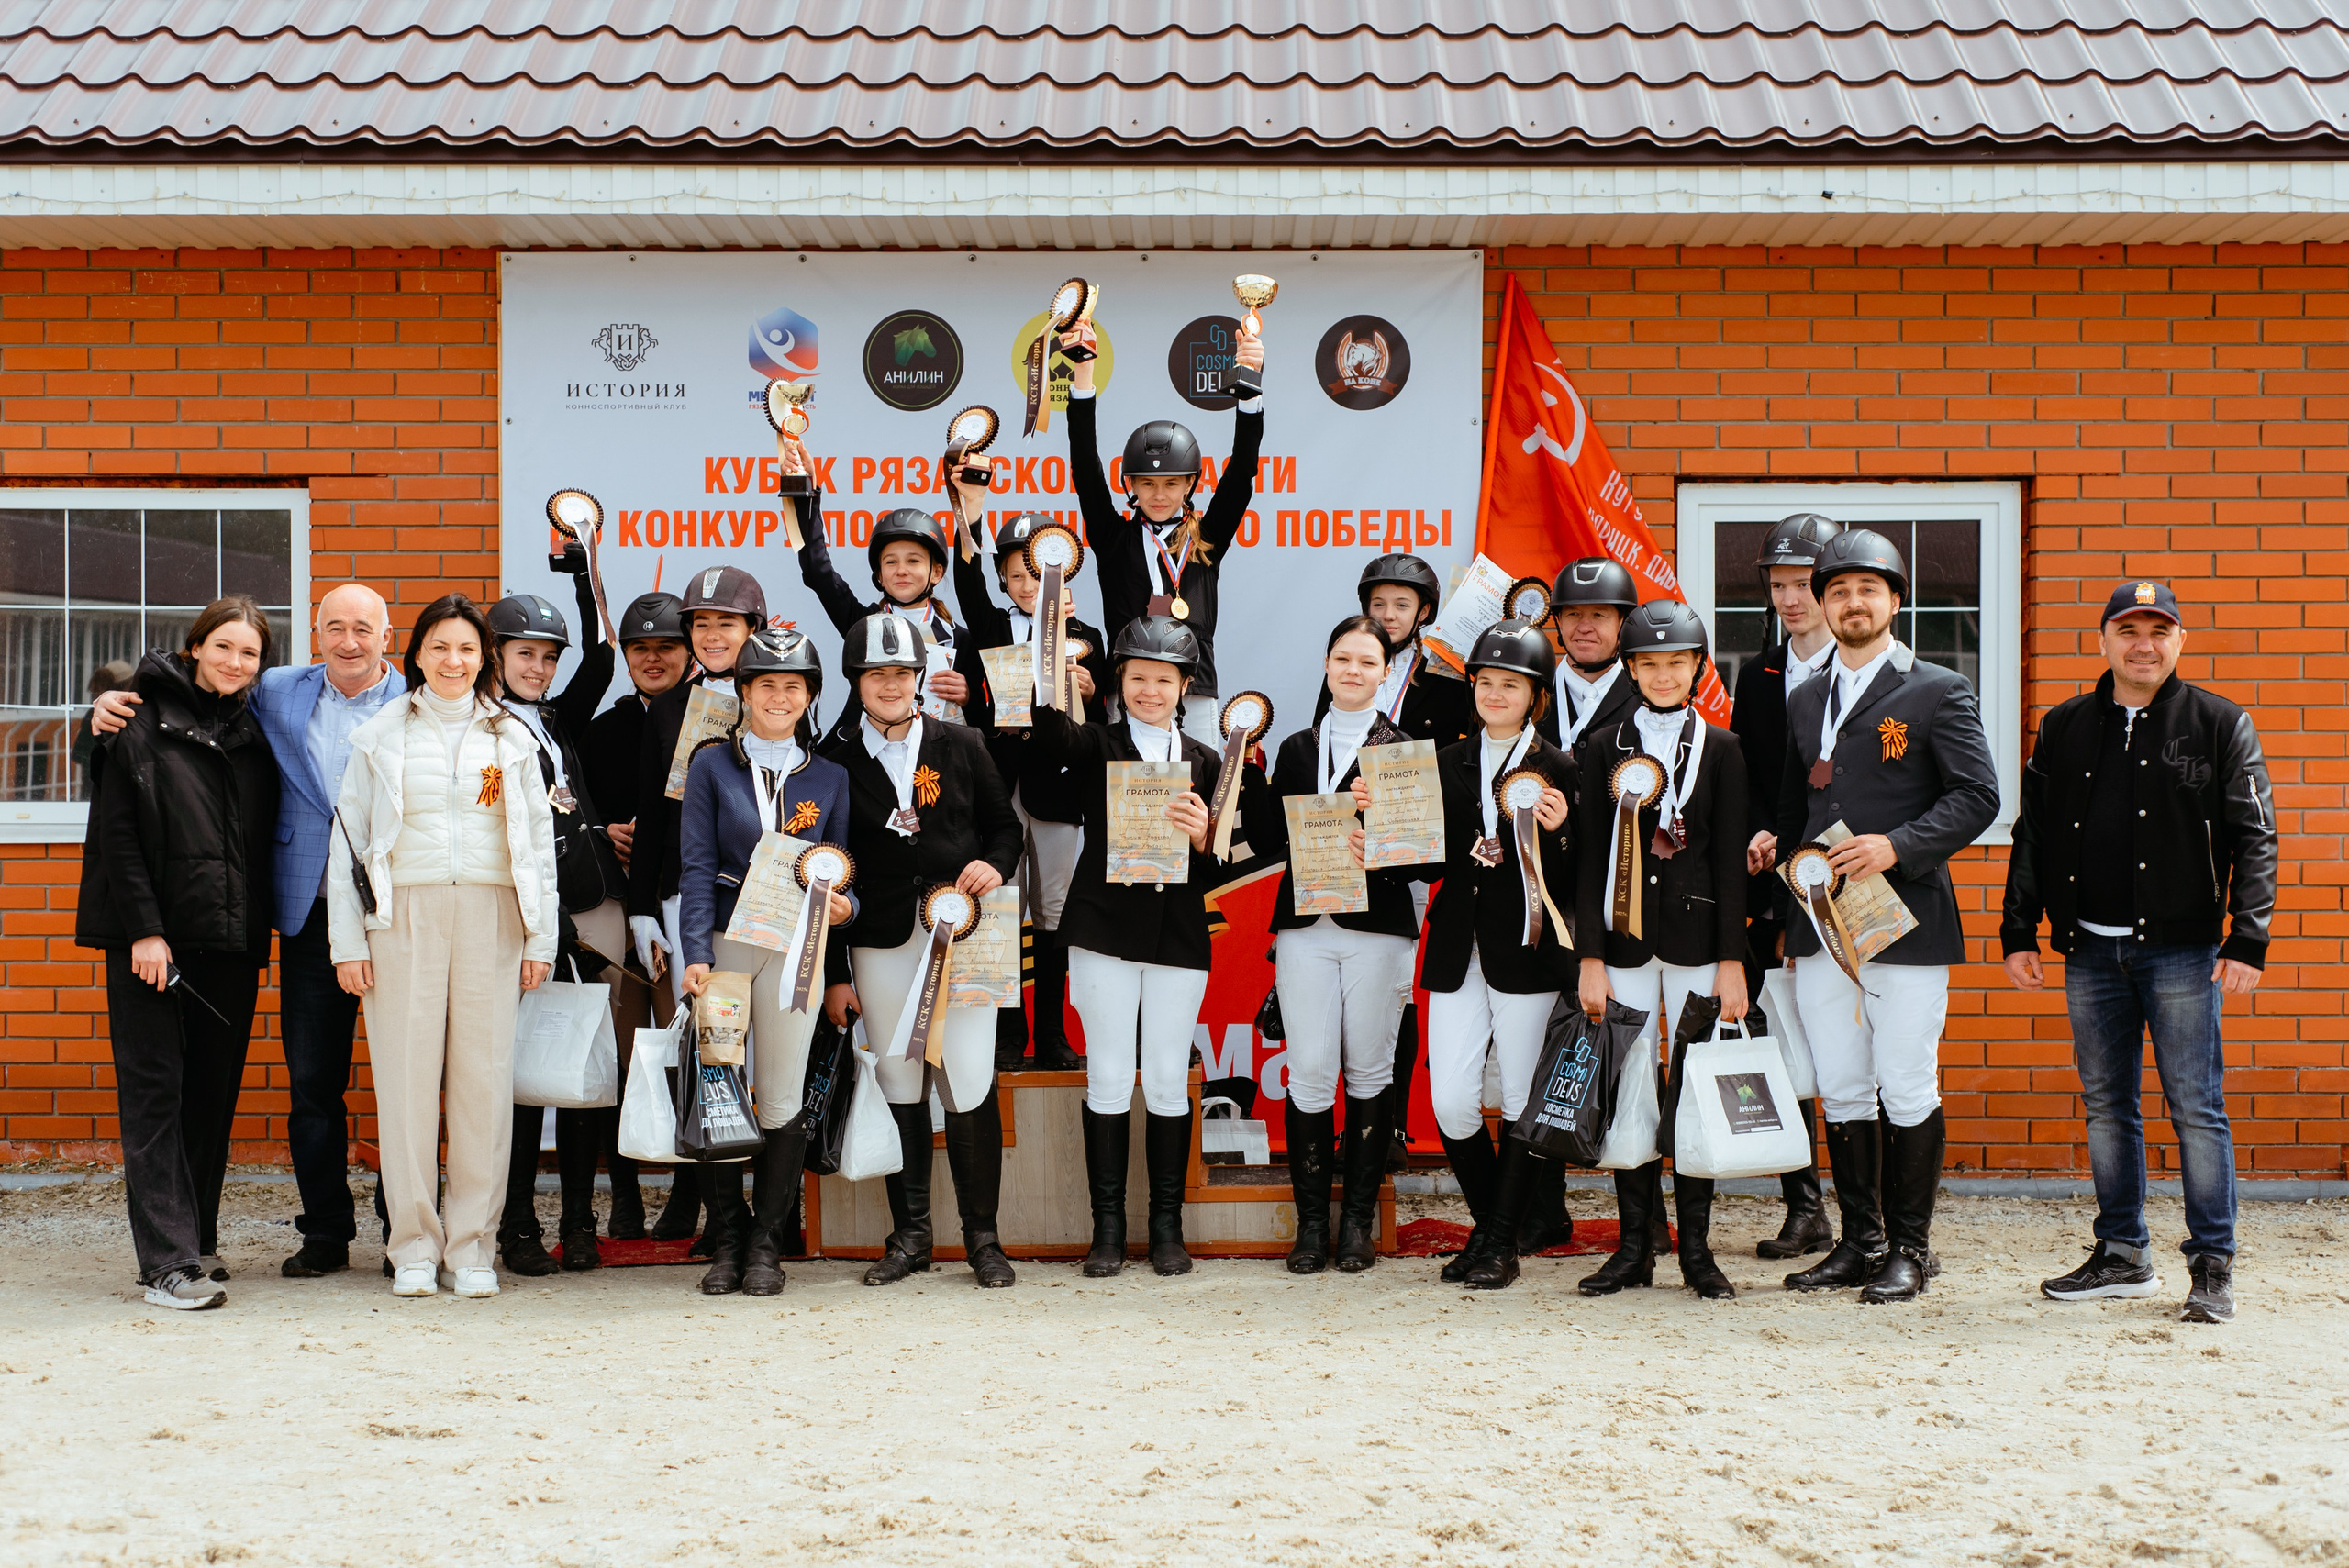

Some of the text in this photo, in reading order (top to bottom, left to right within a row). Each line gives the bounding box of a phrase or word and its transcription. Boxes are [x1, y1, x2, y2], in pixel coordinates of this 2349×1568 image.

[617, 334, 633, 350] И
[1030, 339, 1041, 381] «Истори
[884, 371, 943, 384] АНИЛИН
[1343, 376, 1382, 386] НА КОНЕ
[567, 384, 685, 398] ИСТОРИЯ
[1030, 383, 1039, 405] КСК
[705, 456, 837, 494] КУБК
[1276, 509, 1452, 554] ПОБЕДЫ
[1472, 573, 1505, 601] ГРАМОТ
[1043, 599, 1056, 677] КСК «История»
[702, 716, 744, 734] ГРАМОА
[1217, 755, 1235, 804] «История»
[1378, 770, 1420, 781] ГРАМОТА
[1304, 819, 1343, 829] ГРАМОТА
[1617, 823, 1631, 903] КСК «История»
[1531, 891, 1541, 913] КСК
[800, 904, 821, 979] КСК «История»
[918, 953, 942, 1029] КСК «История»
[702, 1065, 725, 1082] SMO
[704, 1080, 731, 1102] EUS
